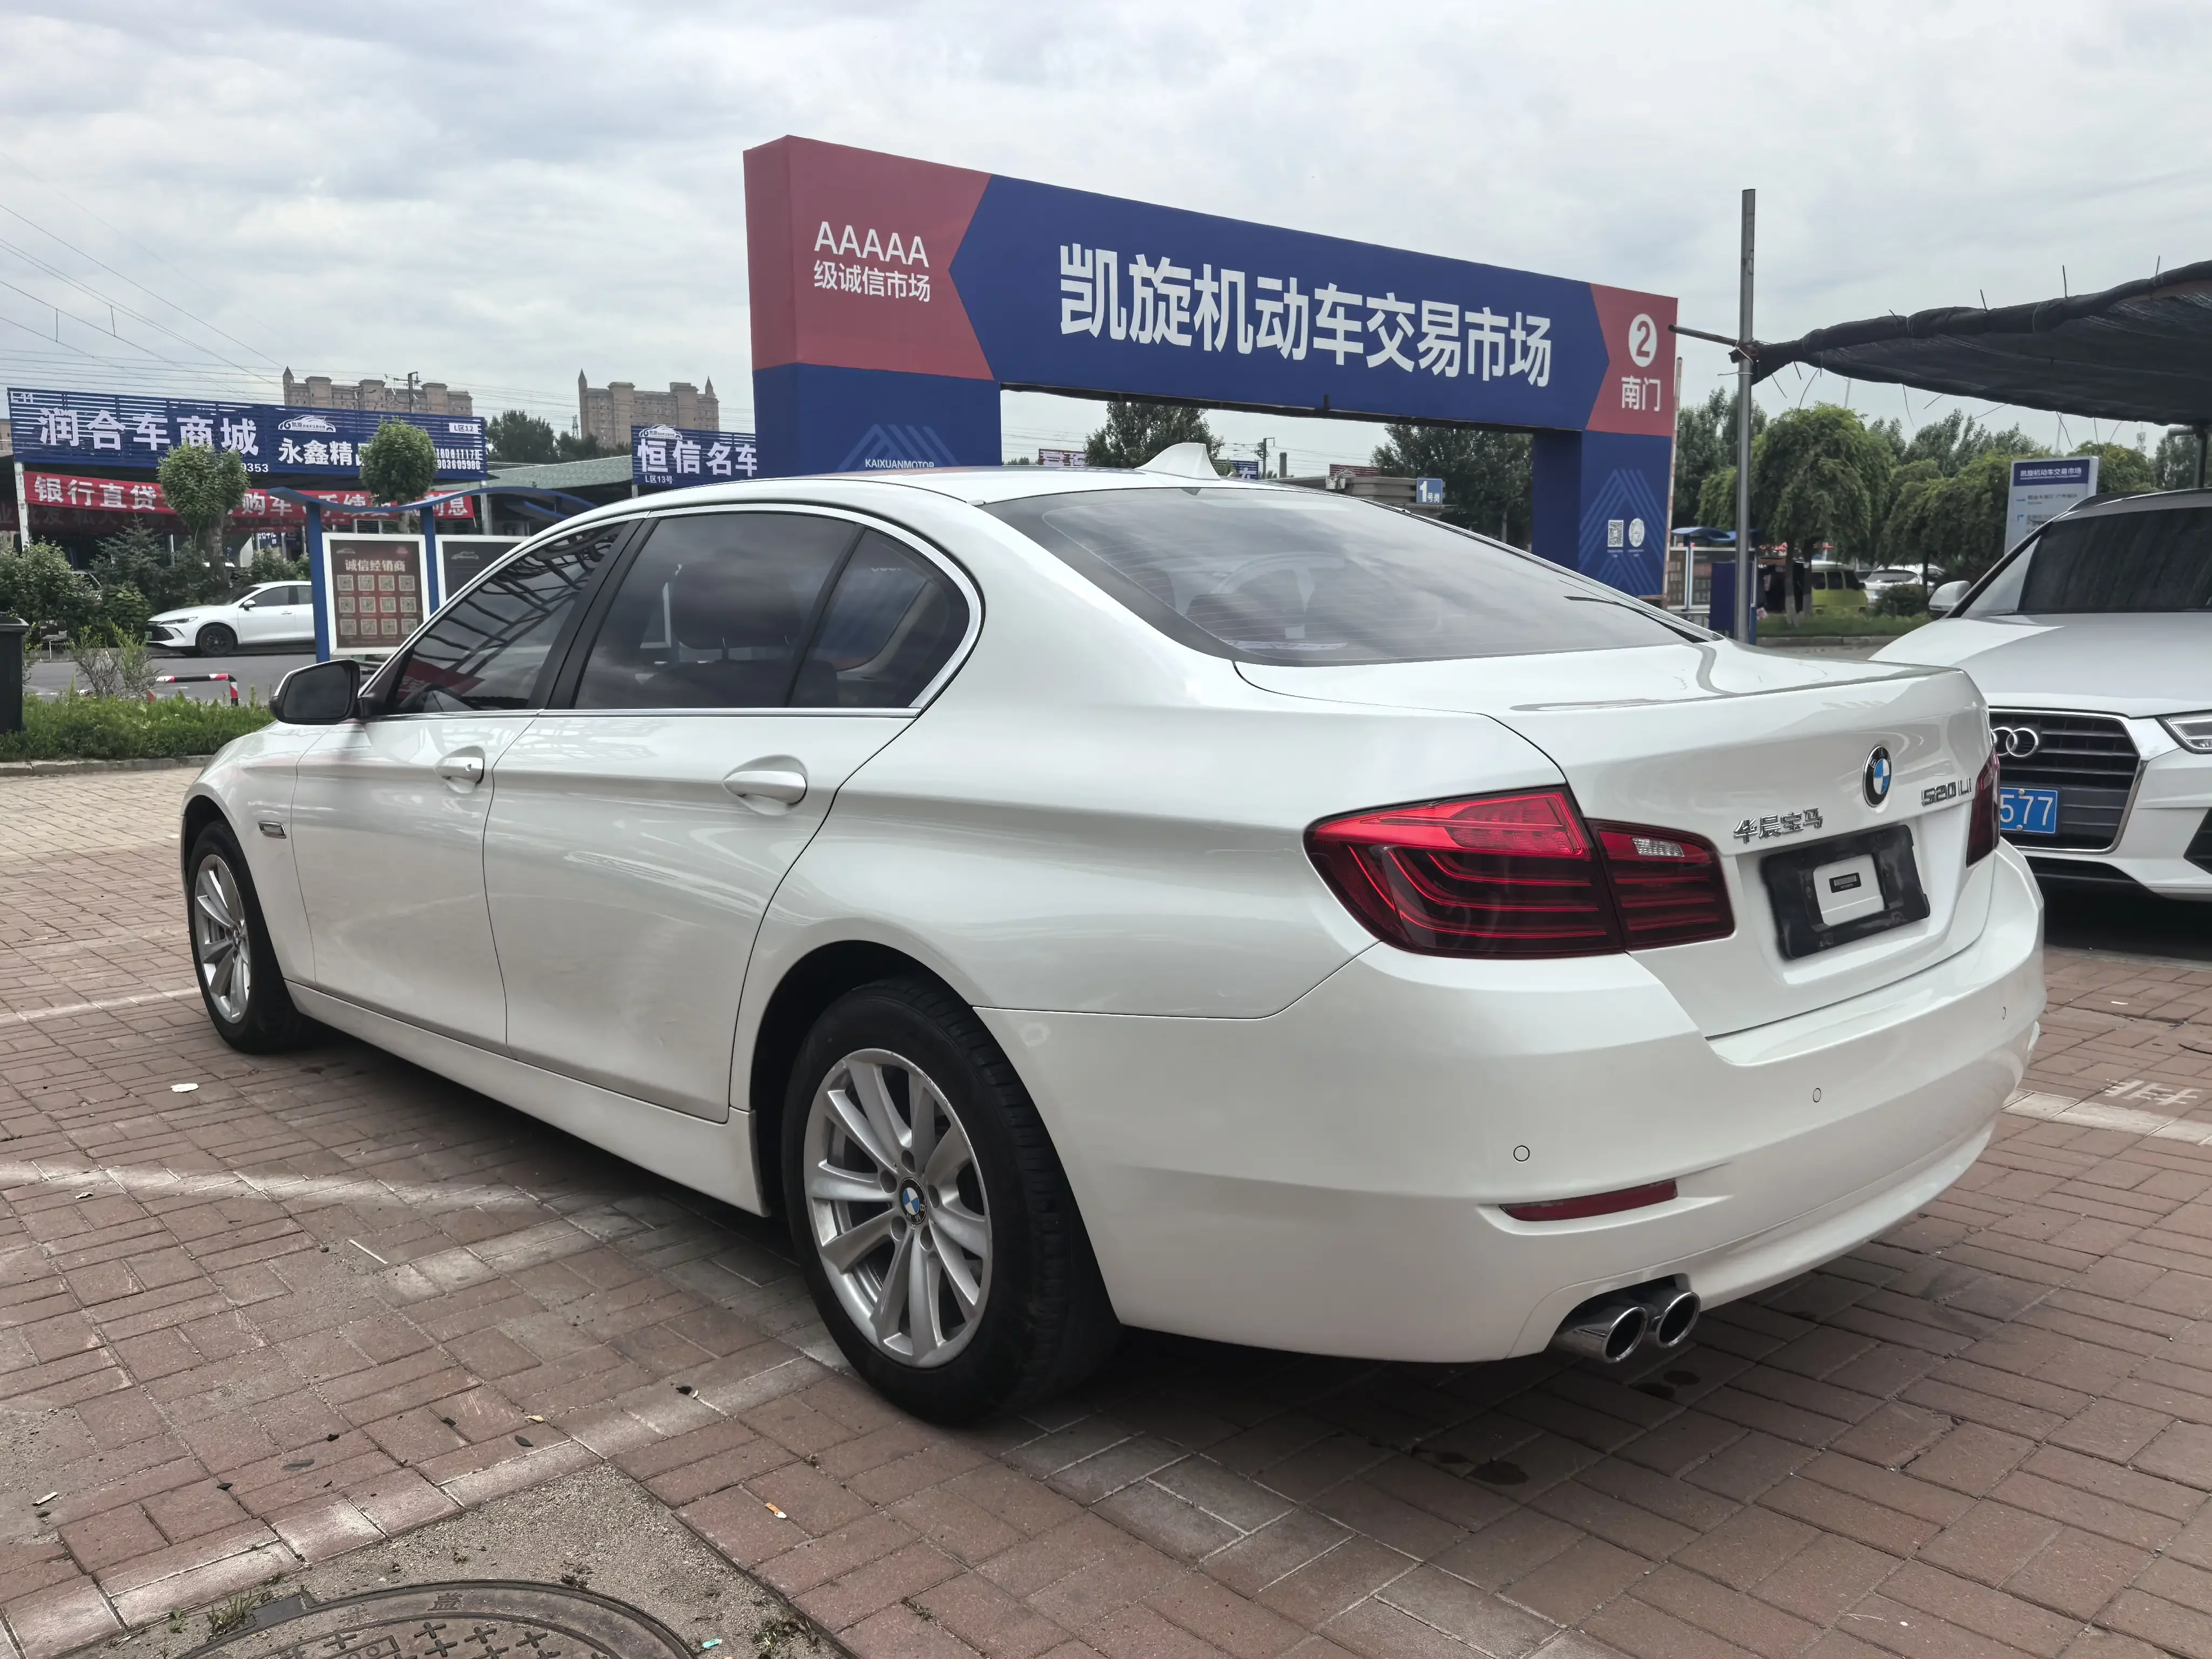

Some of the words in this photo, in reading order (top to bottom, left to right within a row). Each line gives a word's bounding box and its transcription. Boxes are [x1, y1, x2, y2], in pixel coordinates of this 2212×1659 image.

[814, 221, 929, 268] AAAAA
[814, 260, 930, 302] 级诚信市场
[1059, 243, 1552, 387] 凯旋机动车交易市场
[1636, 320, 1651, 359] 2
[1621, 375, 1661, 412] 南门
[38, 407, 259, 456] 润合车商城
[637, 438, 758, 477] 恒信名车
[865, 458, 935, 469] KAIXUANMOTOR
[34, 475, 157, 511] 银行直贷
[645, 475, 673, 484] L区13号
[345, 559, 406, 572] 诚信经销商
[1733, 806, 1823, 844] 华辰宝马
[2000, 794, 2053, 826] 577
